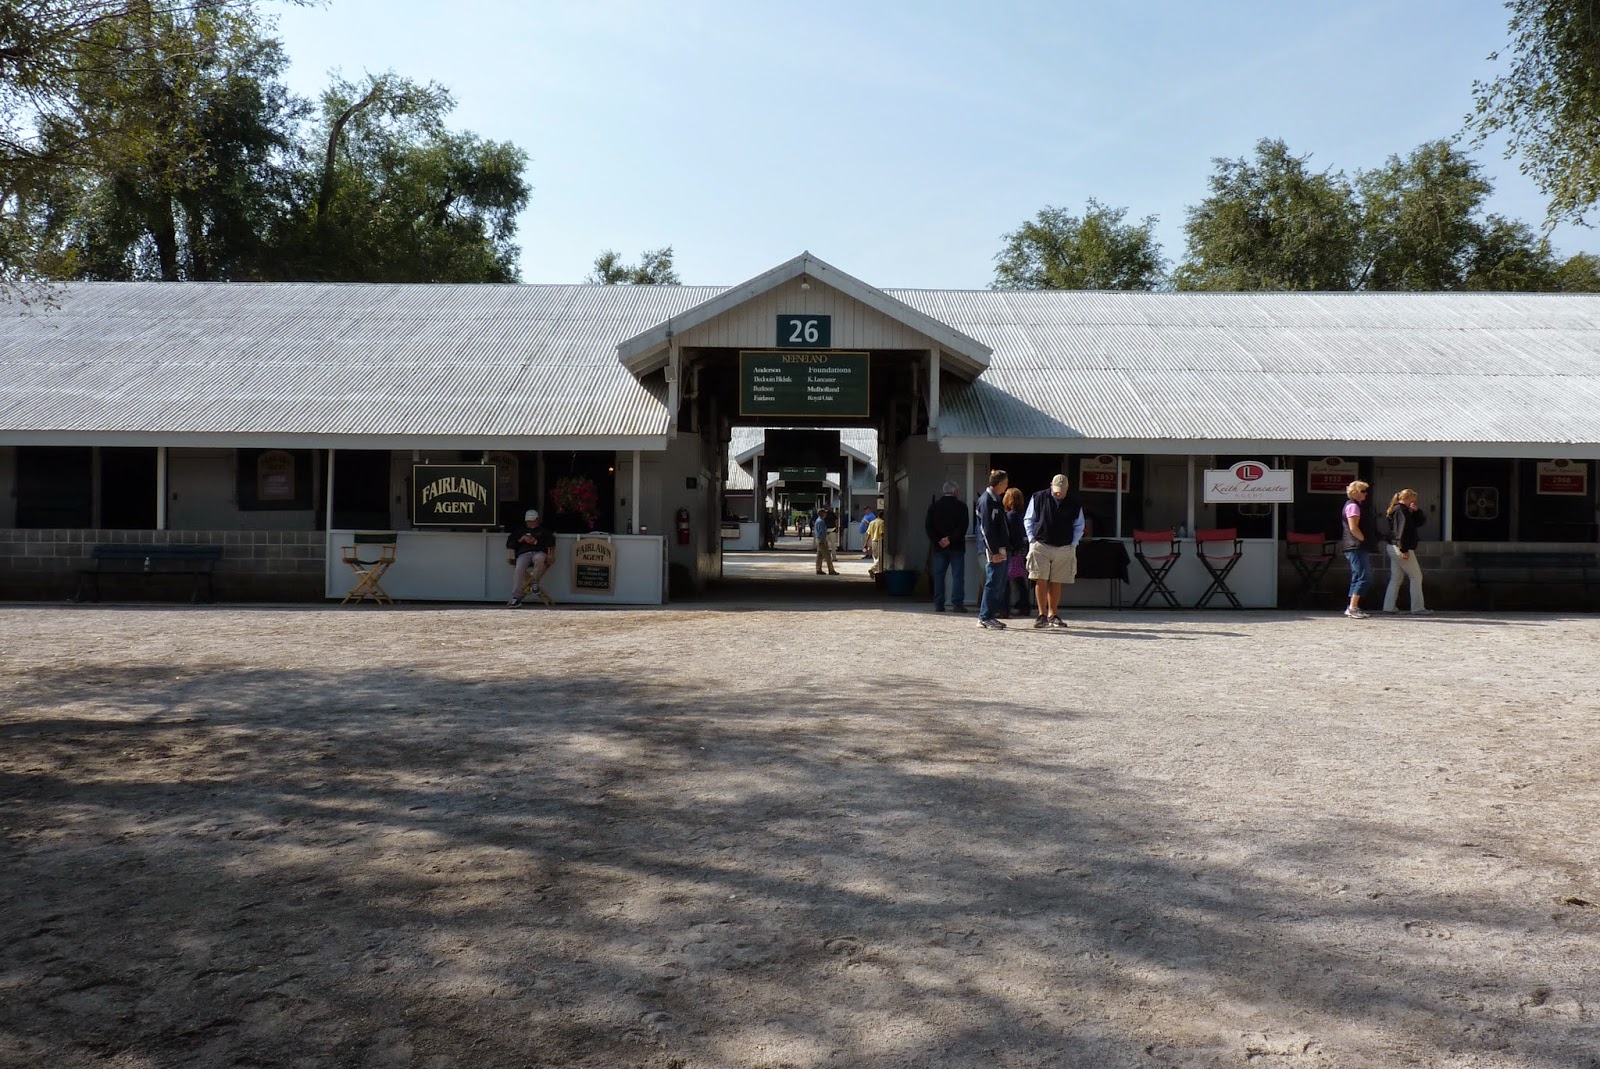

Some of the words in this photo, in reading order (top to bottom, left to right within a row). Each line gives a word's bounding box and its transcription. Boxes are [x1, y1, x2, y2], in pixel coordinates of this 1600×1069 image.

[789, 320, 818, 343] 26
[782, 355, 828, 363] KEENELAND
[1243, 466, 1258, 479] L
[422, 476, 487, 506] FAIRLAWN
[1211, 481, 1245, 494] Keith
[1242, 483, 1288, 492] Lancaster
[434, 501, 475, 513] AGENT
[576, 543, 611, 559] FAIRLAWN
[582, 553, 604, 561] AGENT
